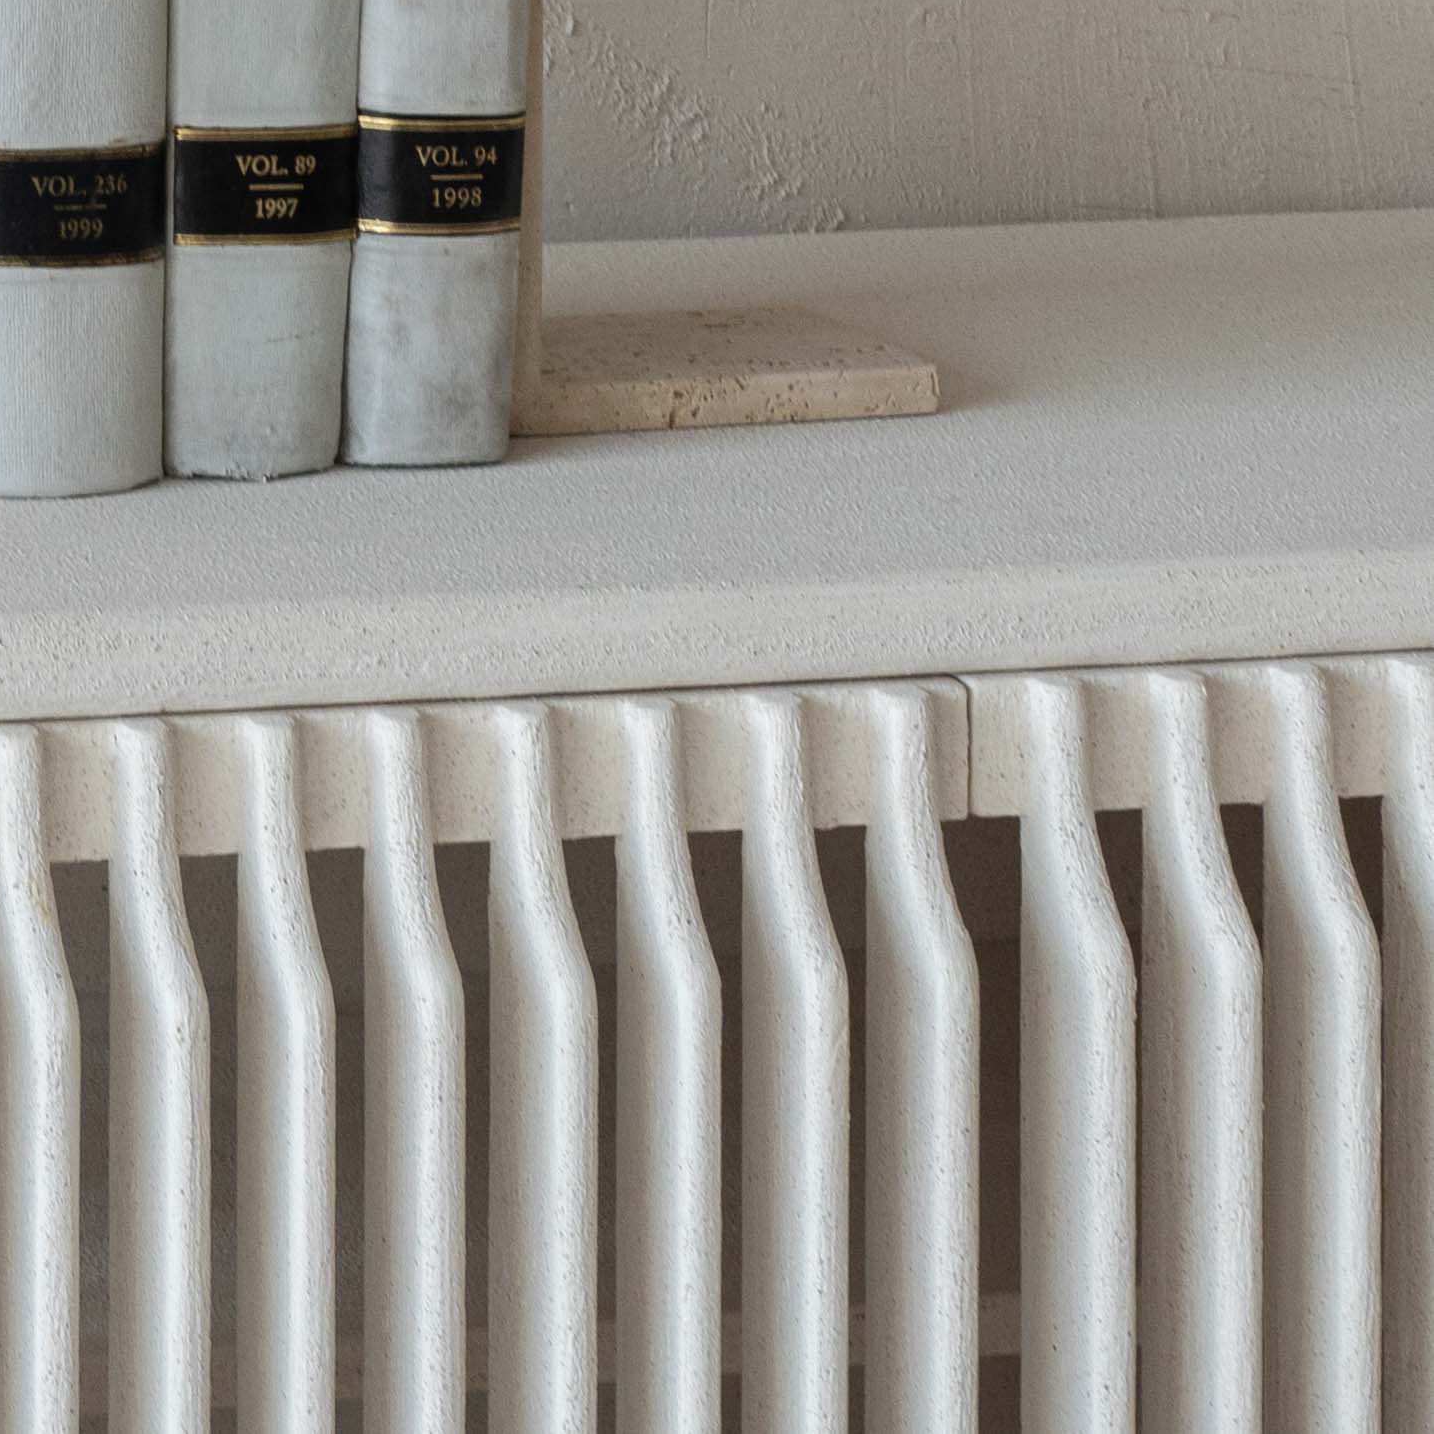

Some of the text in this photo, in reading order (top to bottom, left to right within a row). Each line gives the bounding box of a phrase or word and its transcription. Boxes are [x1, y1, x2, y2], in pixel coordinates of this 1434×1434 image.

[236, 155, 315, 176] VOL. 89
[416, 146, 496, 167] VOL. 94
[31, 174, 128, 197] VOL. 236
[432, 187, 482, 208] 1998
[255, 198, 298, 219] 1997
[60, 219, 103, 240] 1999
